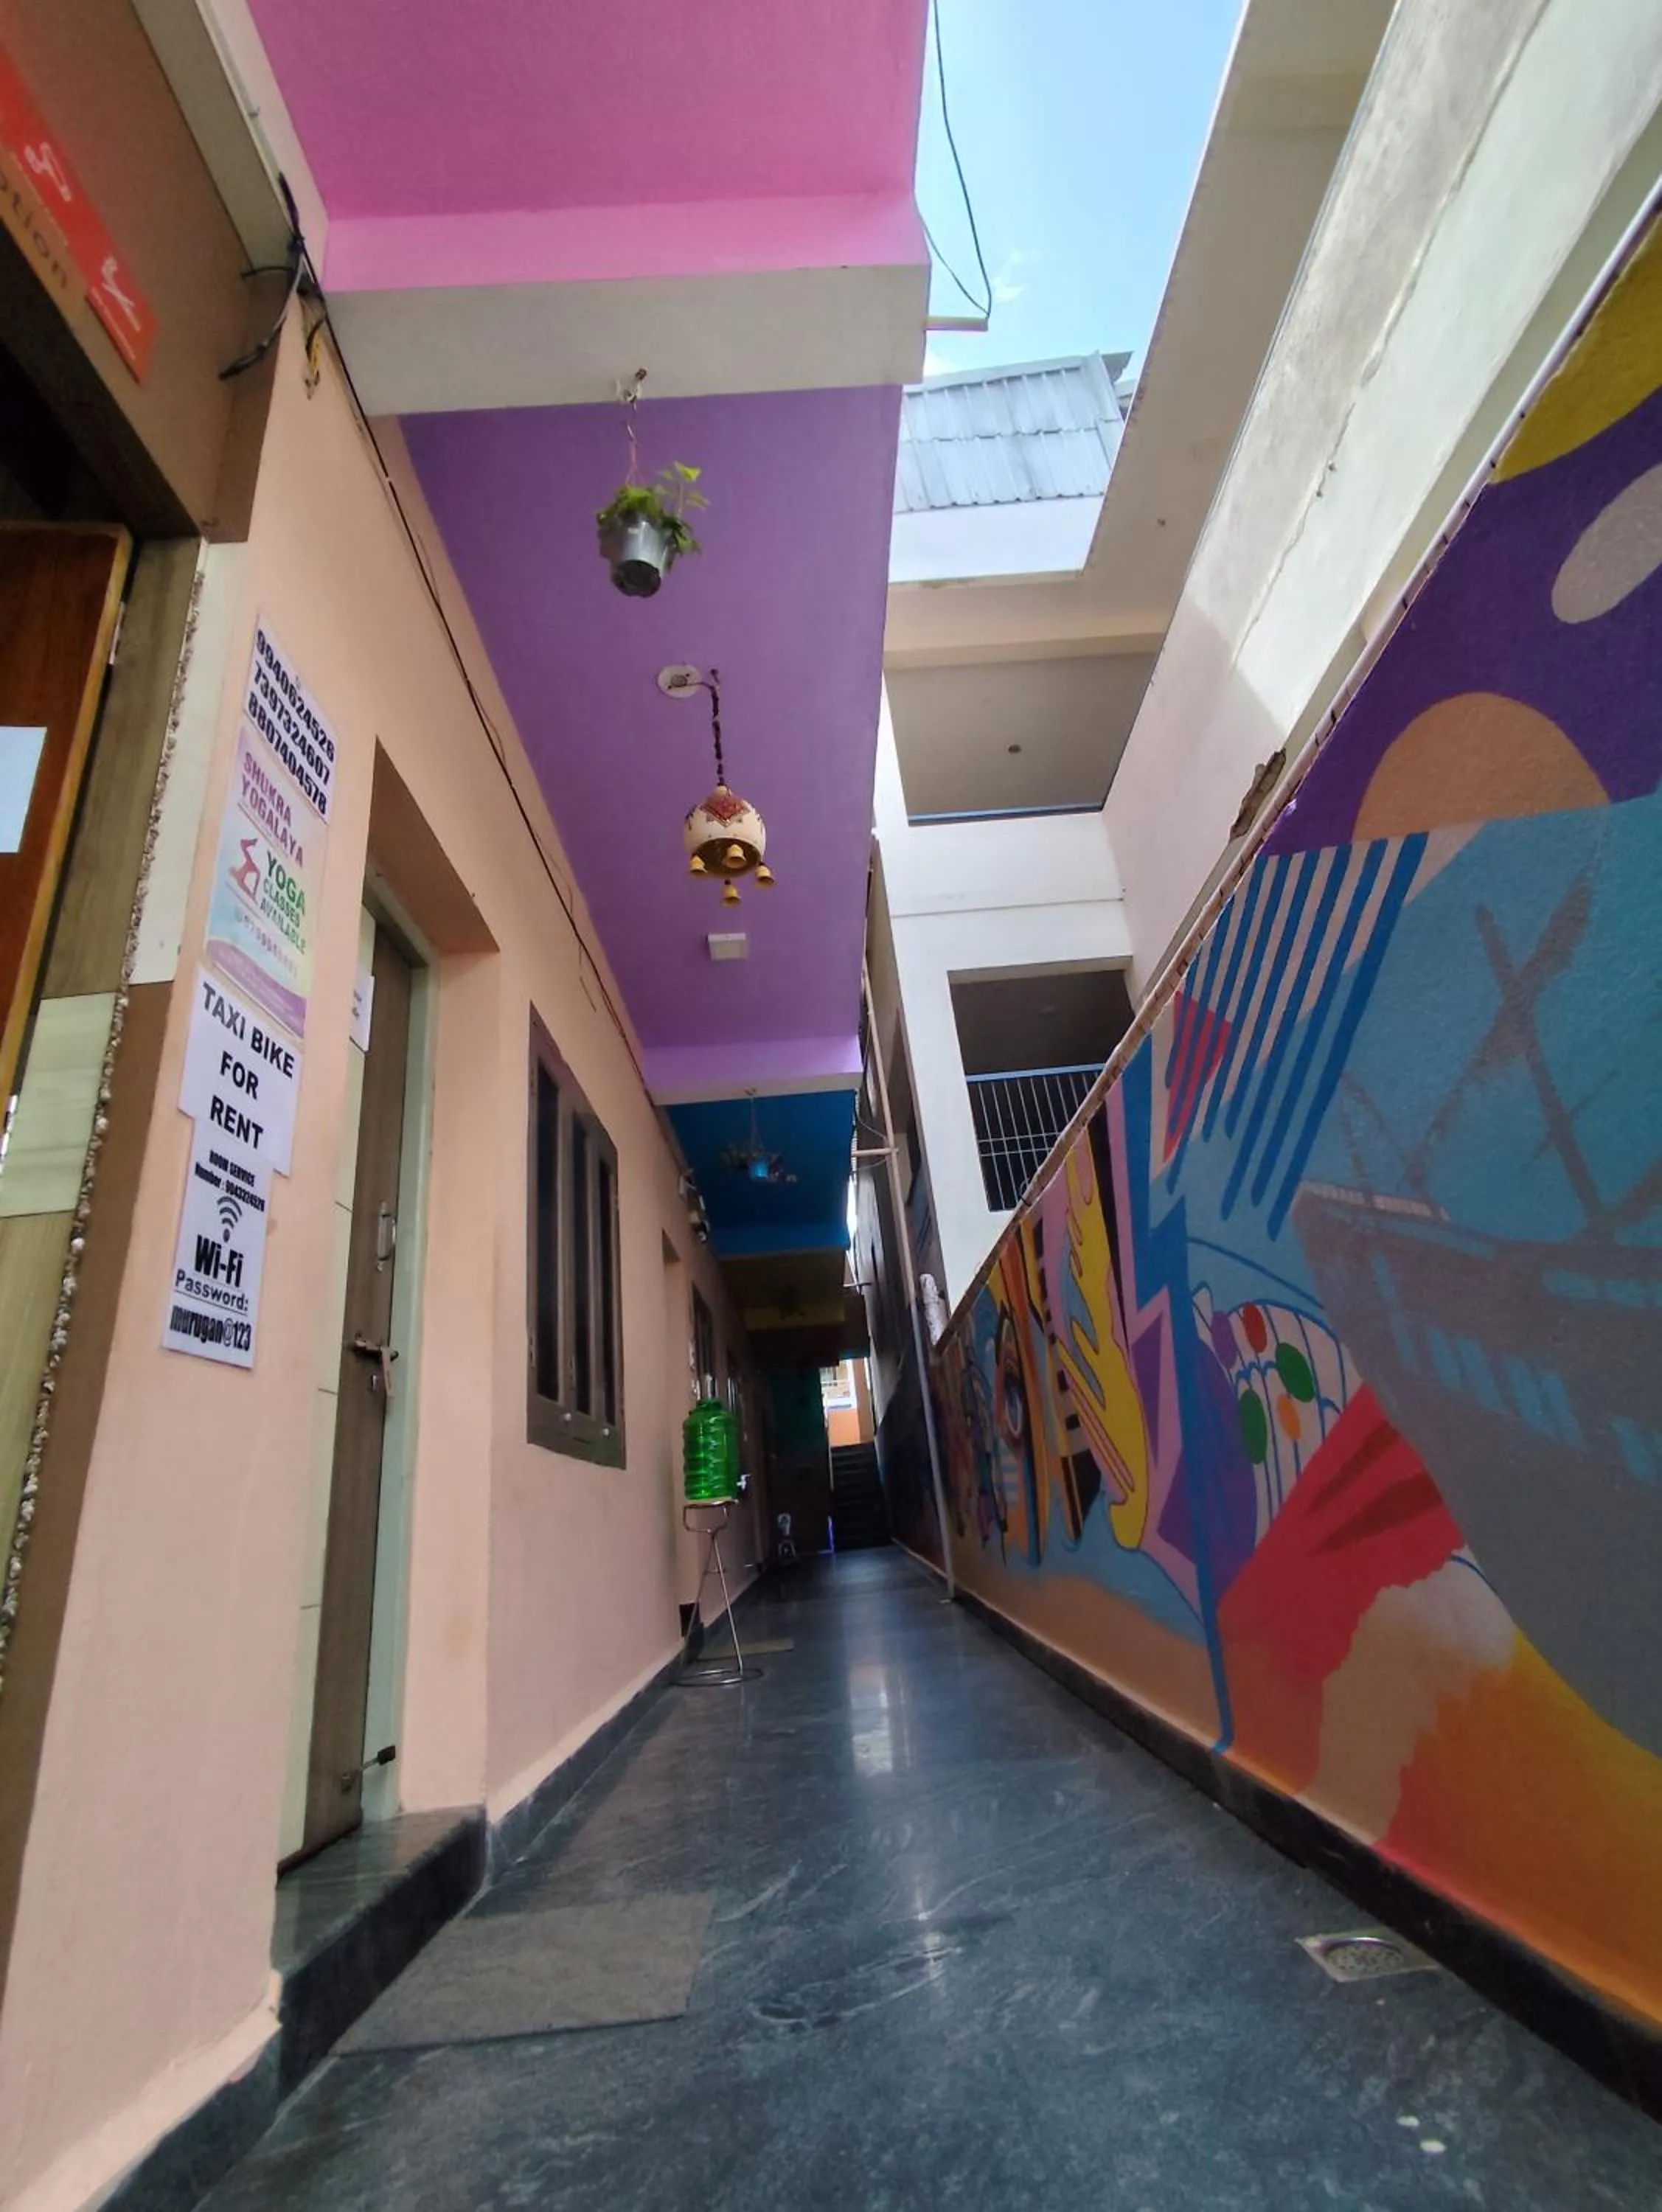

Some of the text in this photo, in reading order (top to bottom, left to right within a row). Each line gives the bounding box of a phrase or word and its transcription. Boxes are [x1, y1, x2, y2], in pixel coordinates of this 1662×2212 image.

[254, 660, 330, 785] 7397324607
[257, 628, 335, 763] 9940624528
[248, 690, 327, 815] 8807404578
[243, 751, 291, 827] SHUKRA
[242, 773, 303, 868] YOGALAYA
[263, 877, 301, 929] CLASSES
[266, 849, 305, 916] YOGA
[260, 897, 306, 956] AVAILABLE
[202, 980, 246, 1041] TAXI
[250, 1025, 295, 1079] BIKE
[220, 1049, 259, 1100] FOR
[209, 1094, 263, 1150] RENT
[229, 1161, 255, 1188] SERVICE
[175, 1268, 248, 1312] Password:
[194, 1234, 244, 1288] Wi-Fi
[170, 1304, 251, 1352] murugan@123
